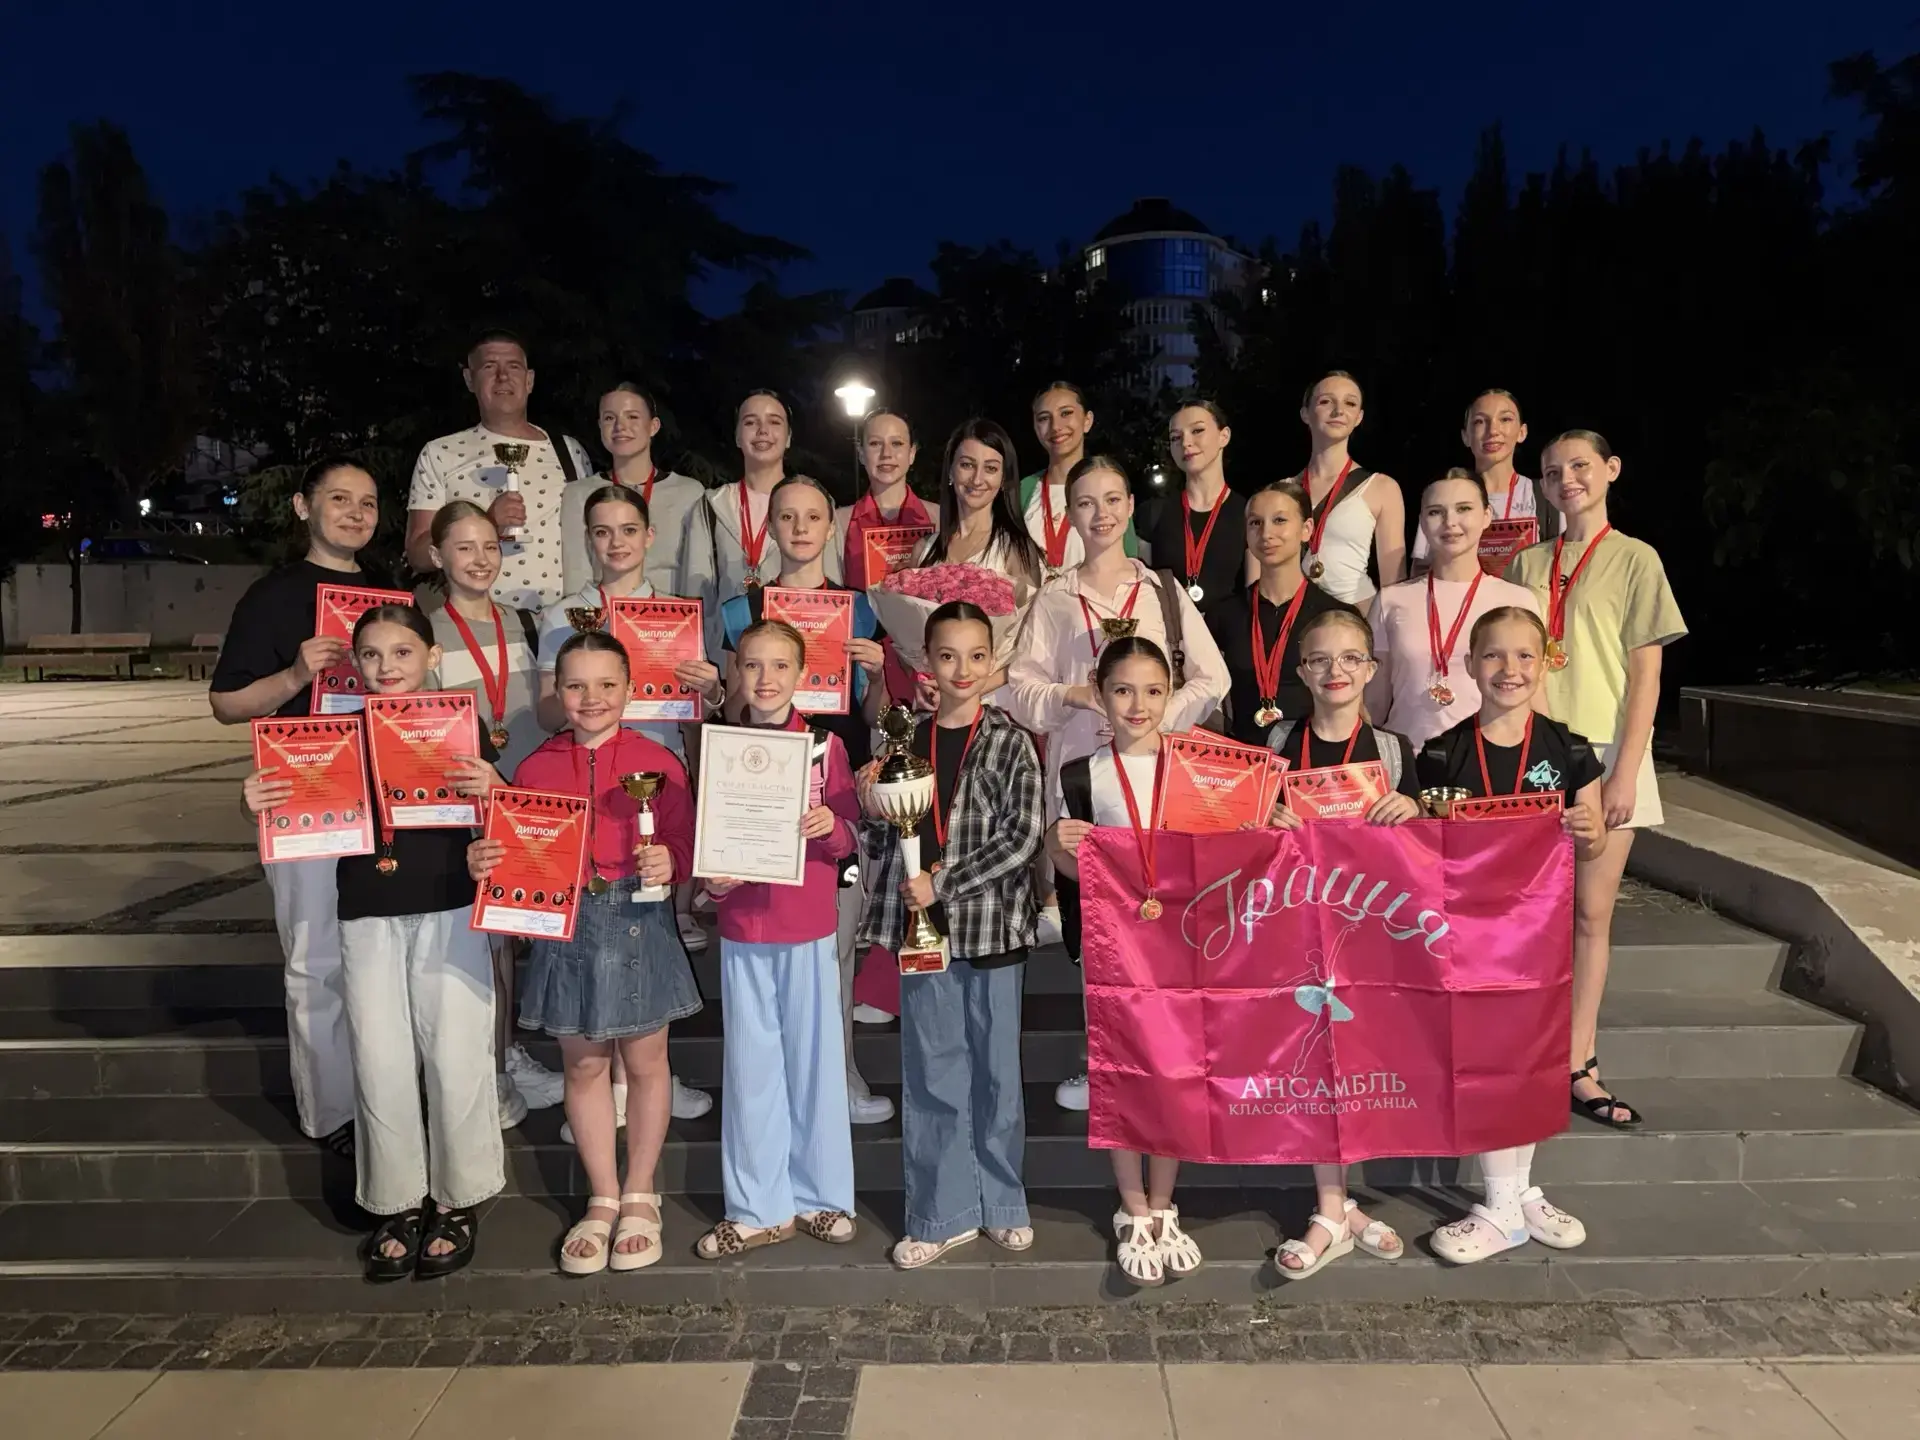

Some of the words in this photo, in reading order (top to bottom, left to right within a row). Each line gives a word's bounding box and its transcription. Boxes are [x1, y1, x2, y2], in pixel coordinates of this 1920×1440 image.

[790, 620, 828, 629] ДИПЛОМ
[638, 630, 676, 639] ДИПЛОМ
[400, 728, 447, 741] ДИПЛОМ
[286, 752, 334, 765] ДИПЛОМ
[1192, 774, 1237, 789] ДИПЛОМ
[1319, 800, 1364, 815] ДИПЛОМ
[515, 824, 559, 838] ДИПЛОМ
[1181, 864, 1450, 960] Грация
[1239, 1072, 1407, 1100] АНСАМБЛЬ
[1228, 1099, 1361, 1116] КЛАССИЧЕСКОГО
[1364, 1096, 1418, 1111] ТАНЦА
